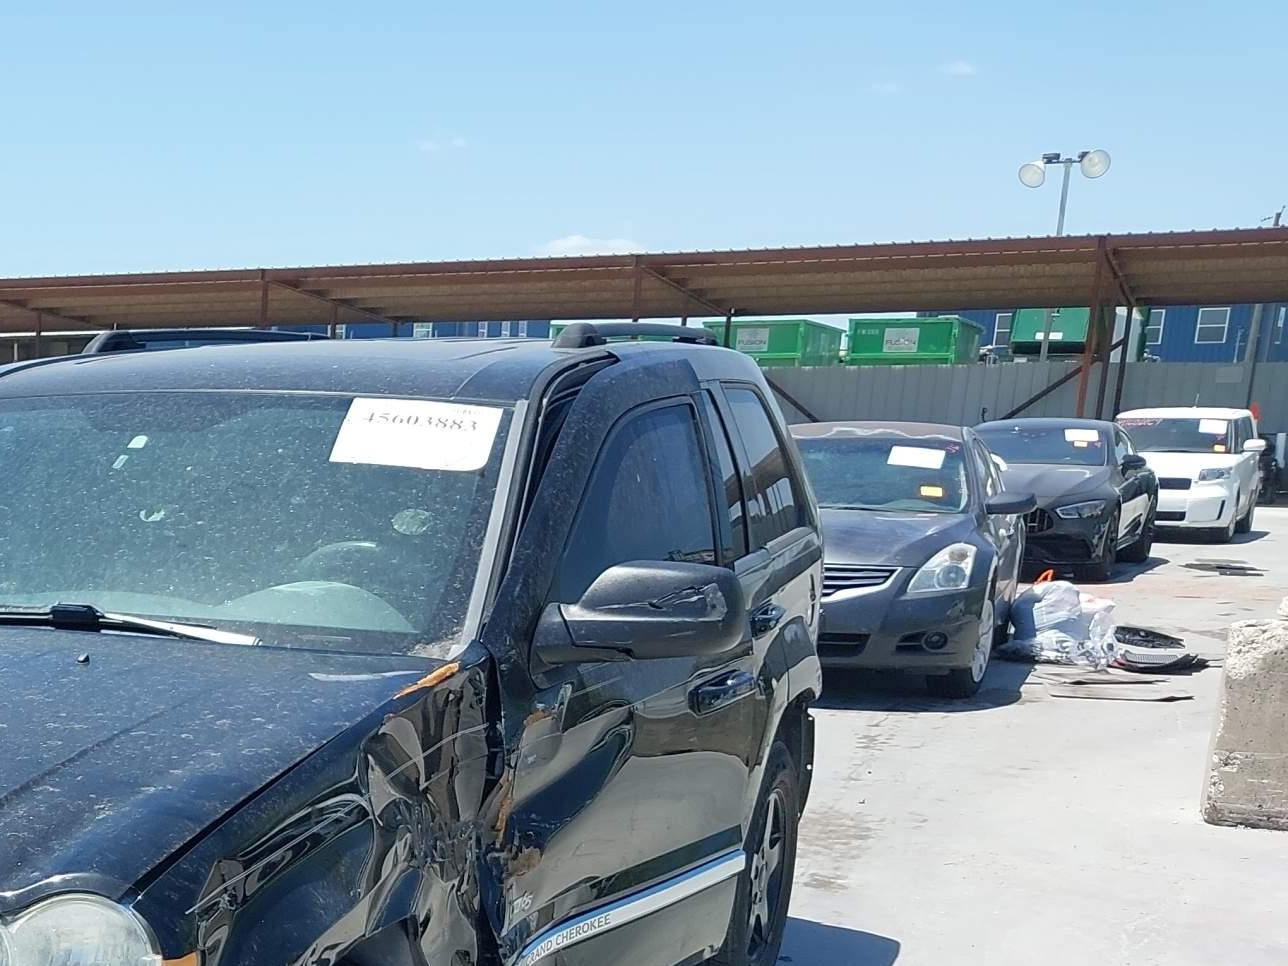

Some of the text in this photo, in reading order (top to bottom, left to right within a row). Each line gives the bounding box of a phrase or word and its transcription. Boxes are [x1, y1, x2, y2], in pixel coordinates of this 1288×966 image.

[363, 411, 479, 432] 45603883
[524, 913, 612, 966] GRAND CHEROKEE
